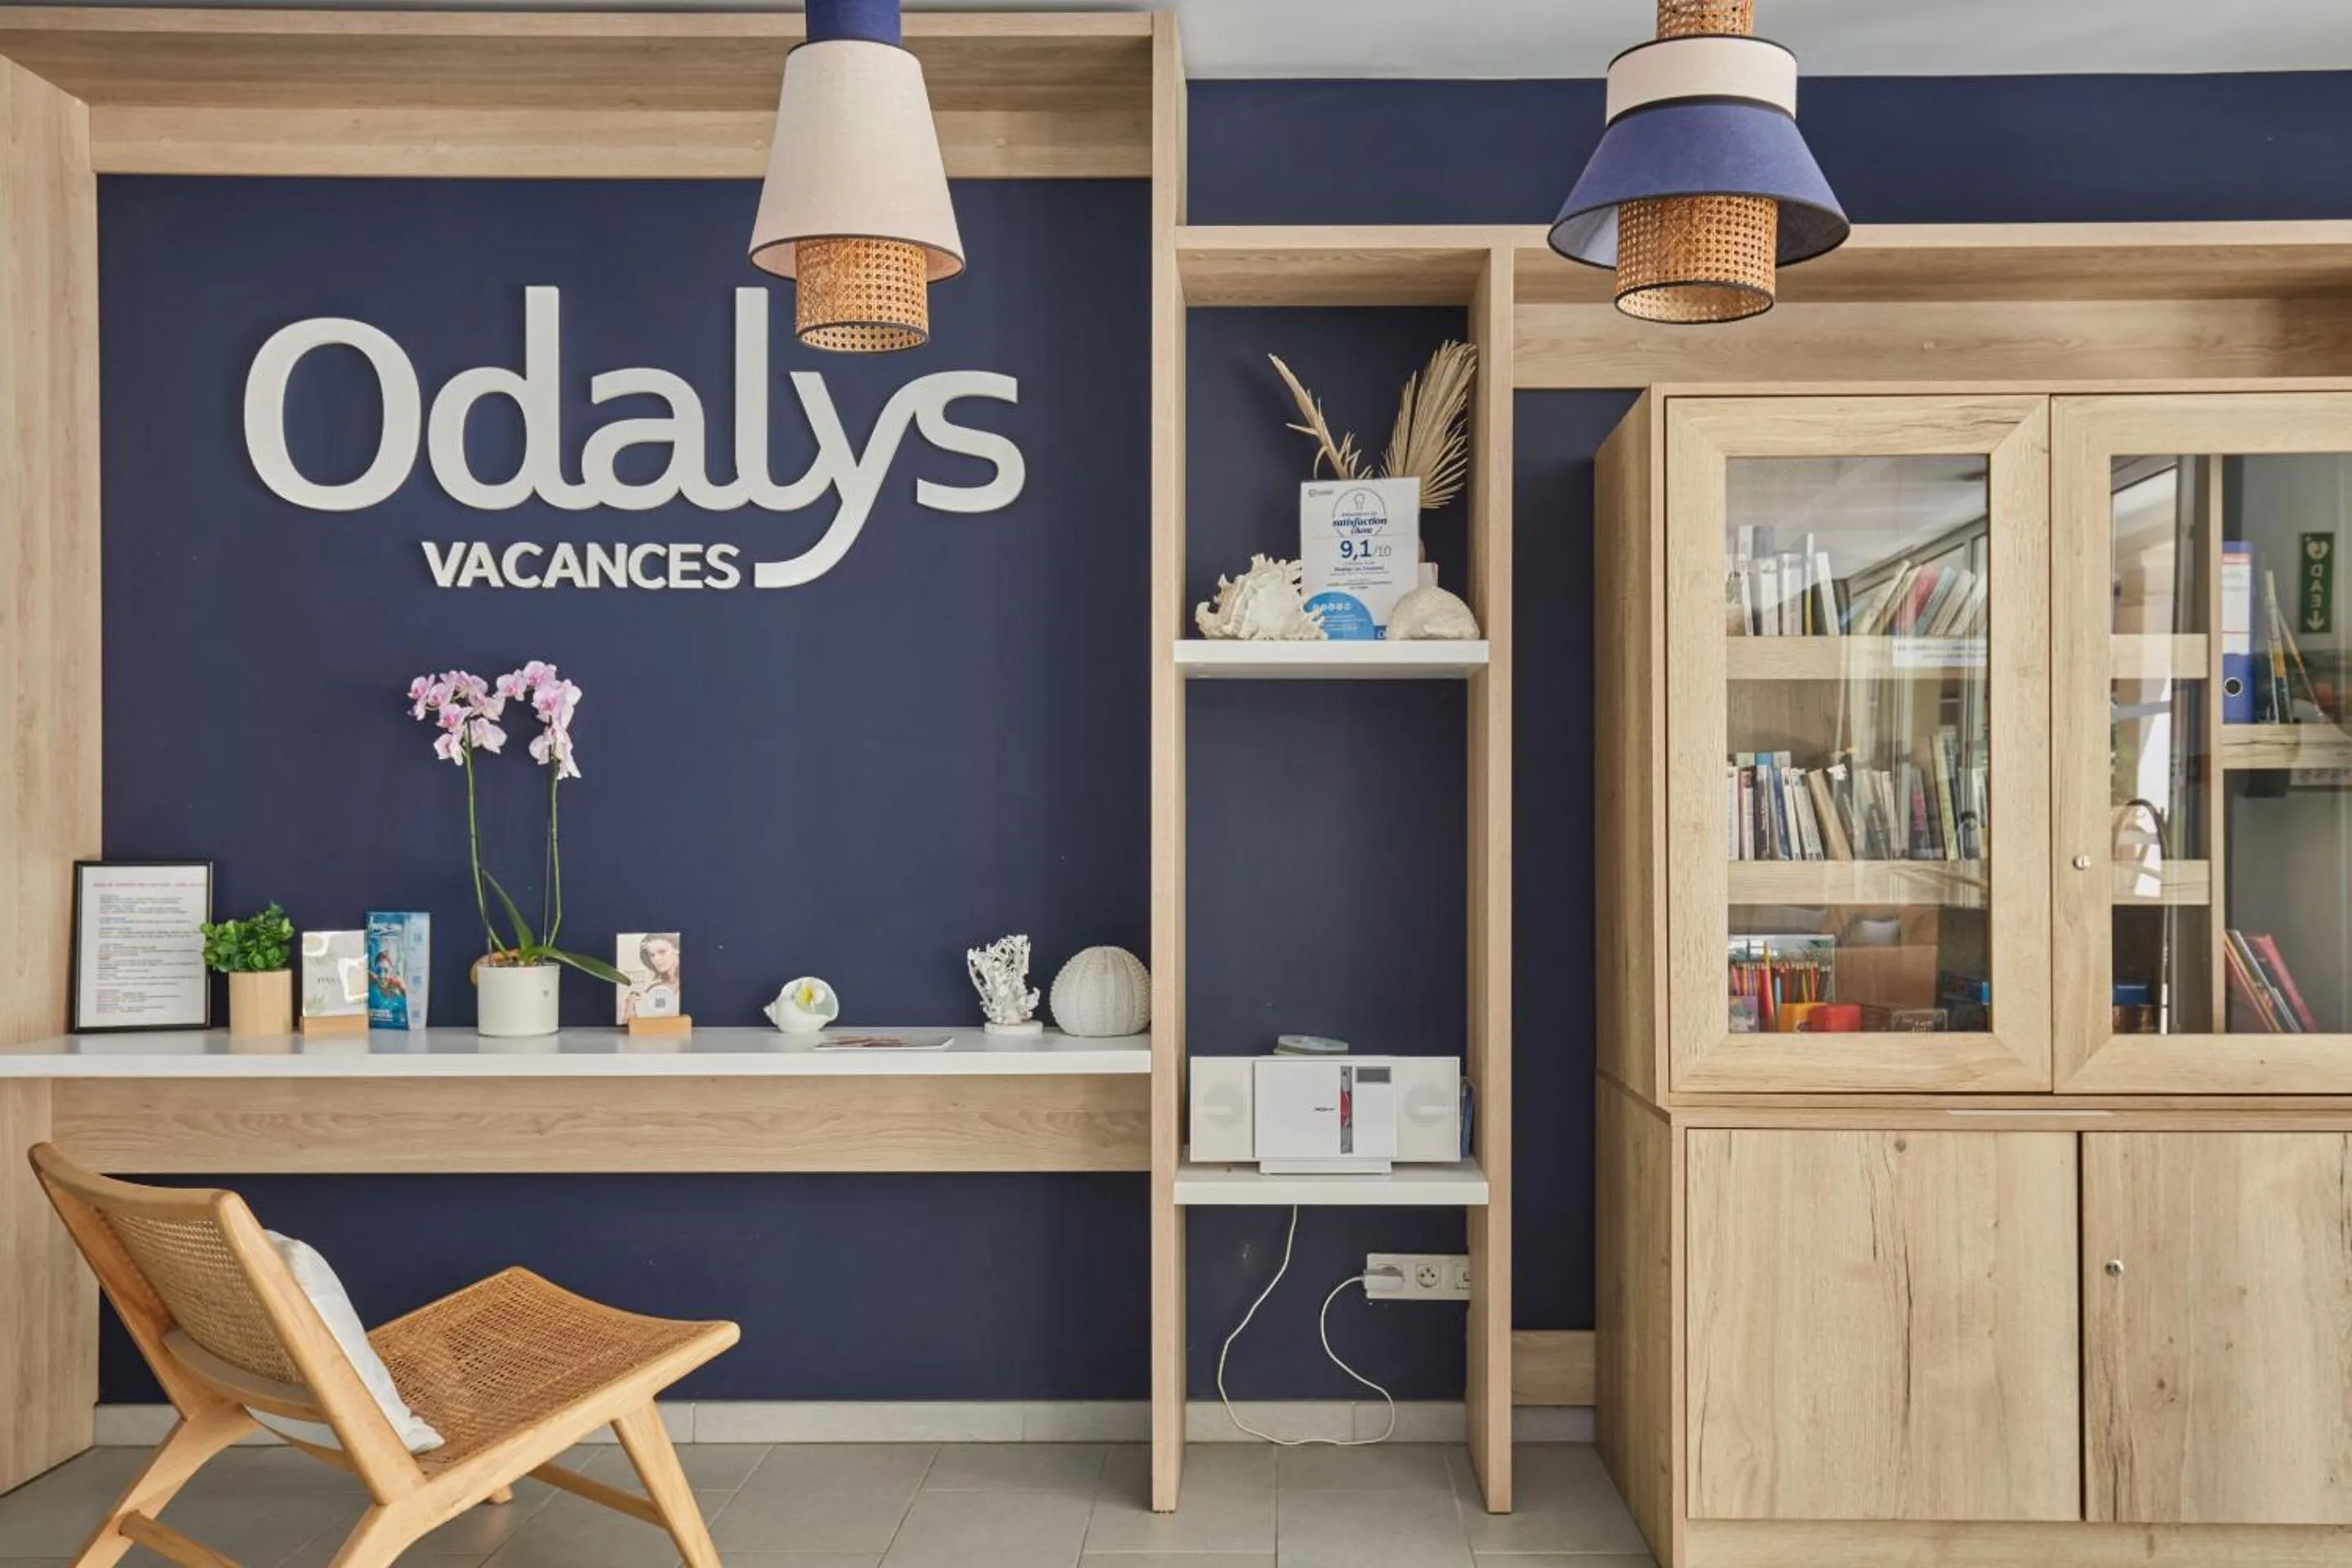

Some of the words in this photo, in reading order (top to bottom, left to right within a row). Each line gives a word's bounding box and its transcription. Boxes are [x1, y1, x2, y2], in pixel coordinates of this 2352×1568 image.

[243, 286, 1026, 589] Odalys
[1332, 517, 1388, 528] satisfaction
[421, 541, 741, 590] VACANCES
